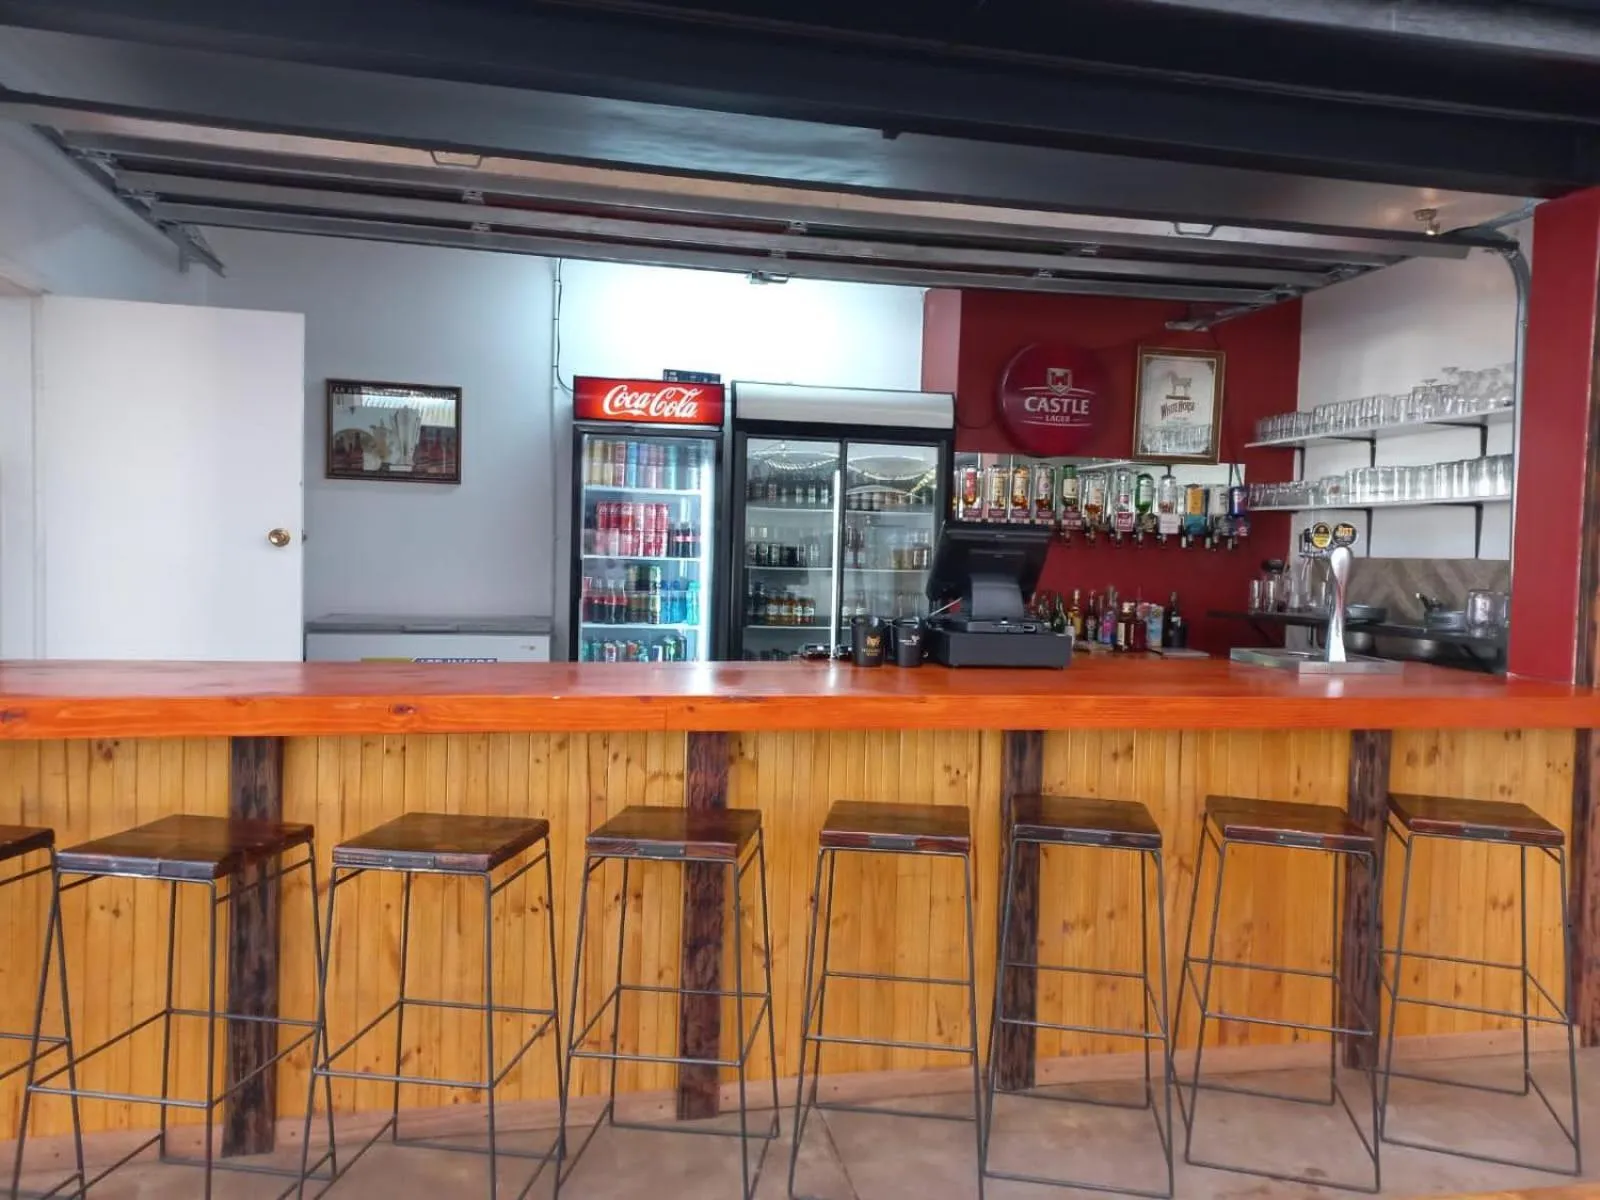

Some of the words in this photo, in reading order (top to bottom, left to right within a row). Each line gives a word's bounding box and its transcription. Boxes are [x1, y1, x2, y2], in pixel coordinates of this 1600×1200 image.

[602, 384, 704, 418] Coca-Cola
[1024, 396, 1089, 414] CASTLE
[1045, 414, 1071, 424] LAGER
